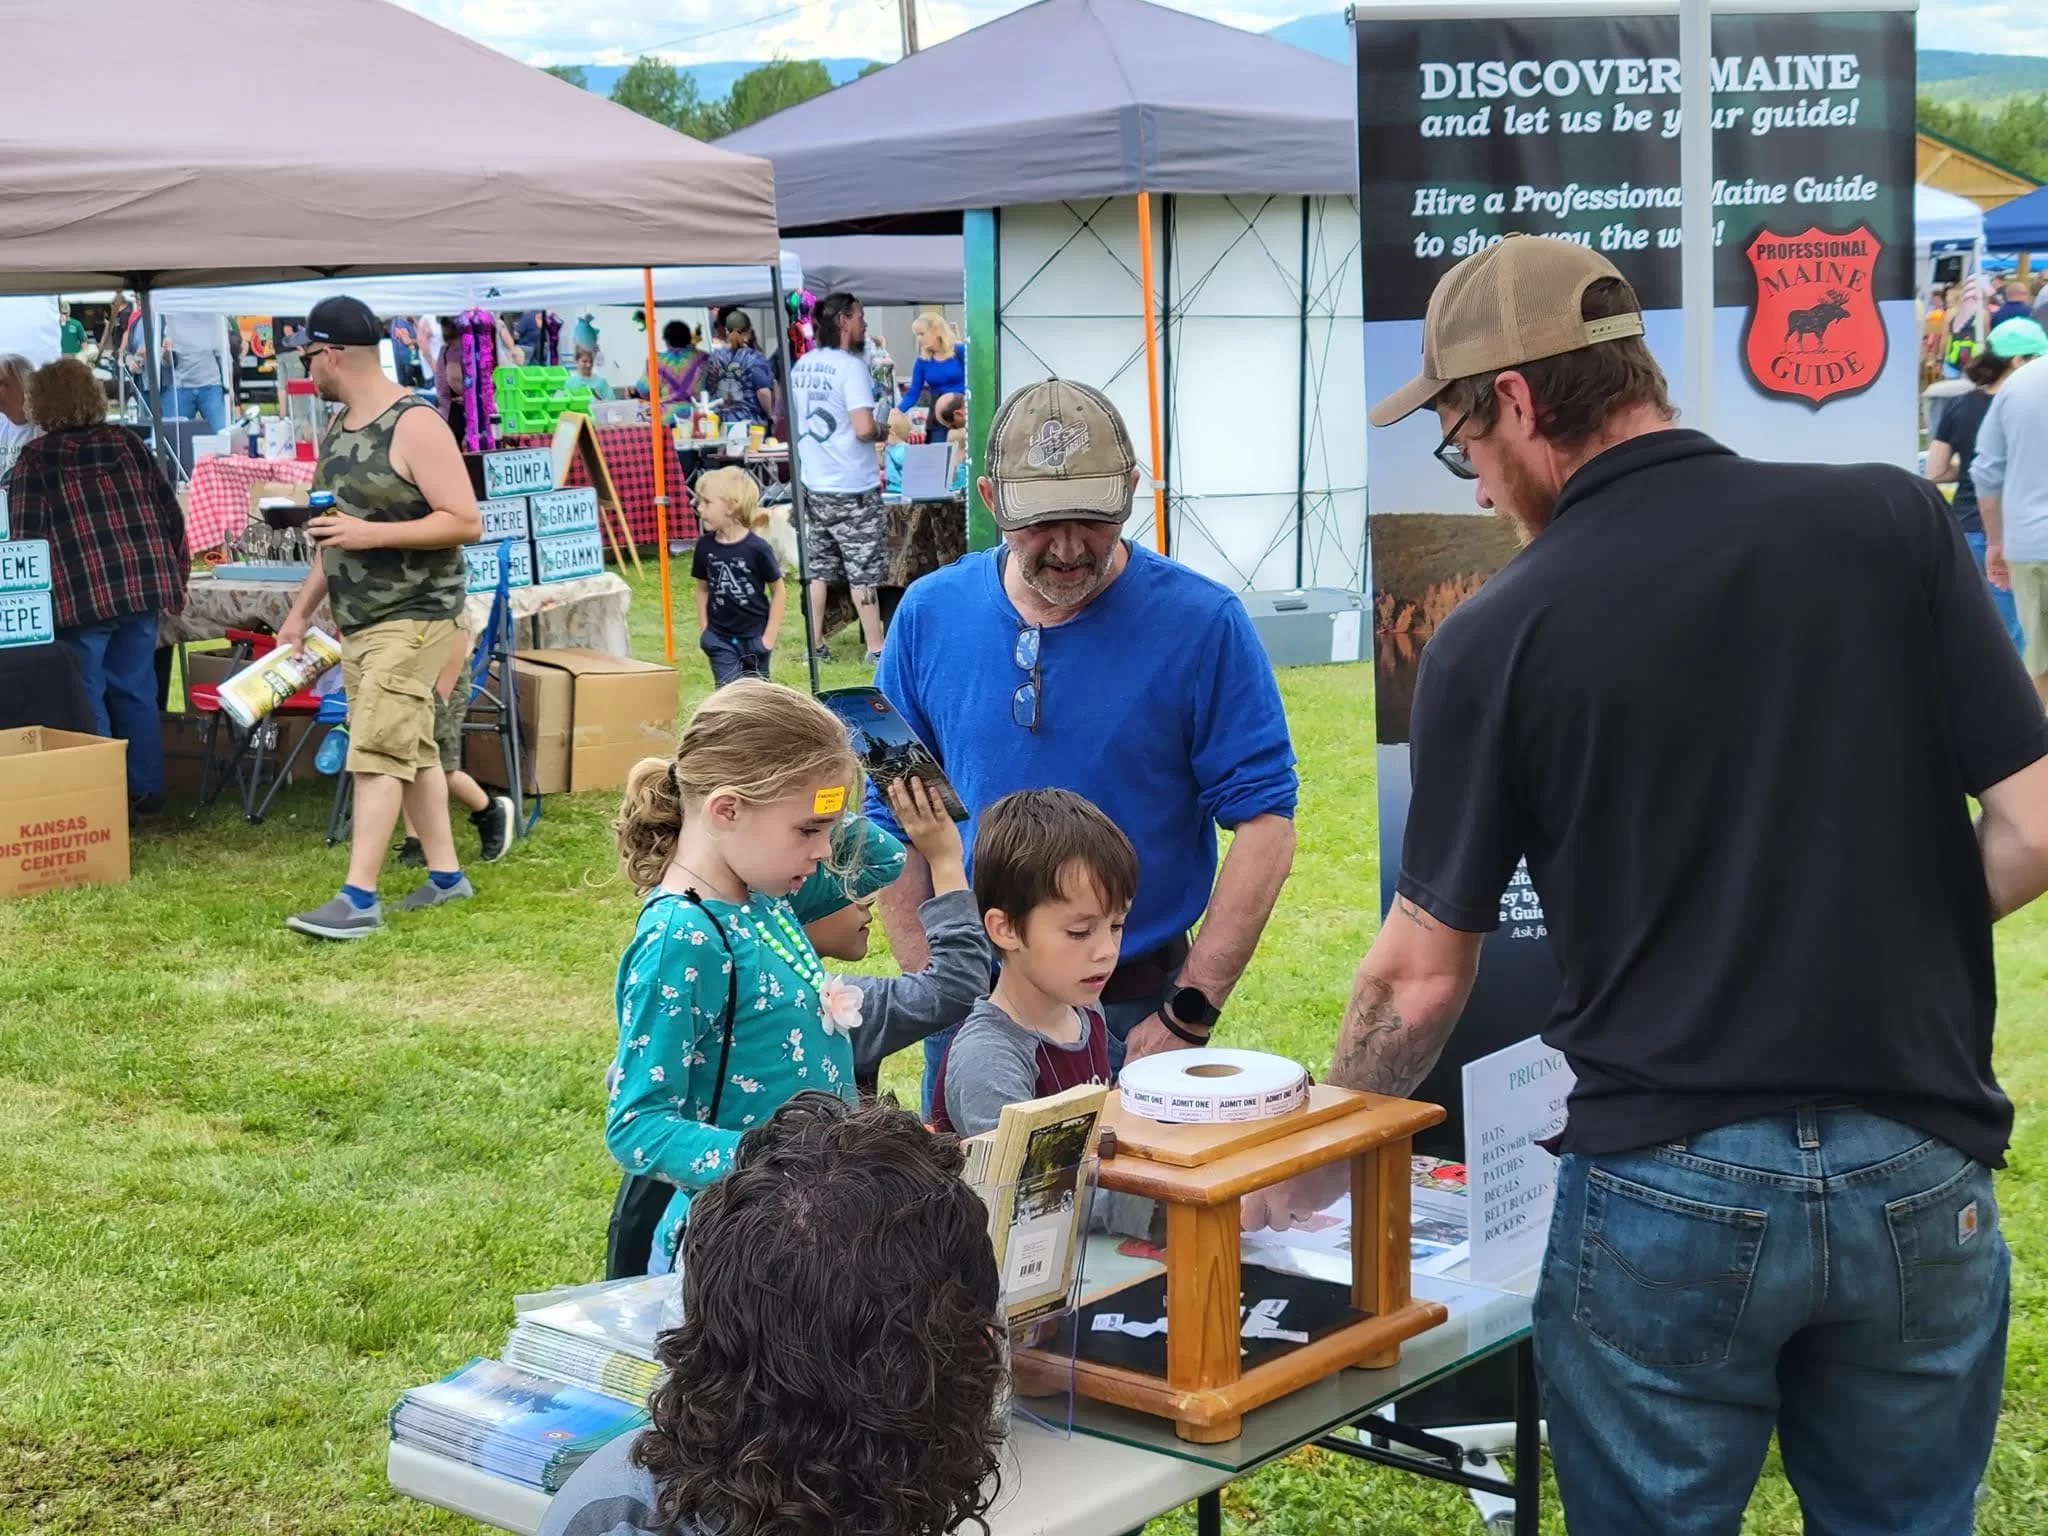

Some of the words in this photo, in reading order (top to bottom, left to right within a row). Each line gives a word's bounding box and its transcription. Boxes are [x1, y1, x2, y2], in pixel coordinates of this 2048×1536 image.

[1420, 58, 1682, 99] DISCOVER
[1710, 54, 1861, 92] MAINE
[1420, 106, 1491, 137] and
[1503, 105, 1550, 135] let
[1560, 110, 1602, 133] us
[1612, 102, 1652, 132] be
[1661, 106, 1744, 138] yur
[1751, 97, 1860, 136] guide!
[1412, 187, 1476, 216] Hire
[1483, 193, 1505, 213] a
[1511, 182, 1683, 219] Professiona
[1793, 174, 1879, 203] Guide
[1413, 231, 1445, 258] to
[1452, 228, 1516, 256] sho
[1600, 222, 1649, 251] the
[1756, 239, 1869, 261] PROFESSIONAL
[1761, 261, 1868, 299] MAINE
[1770, 351, 1865, 386] GUIDE
[504, 461, 551, 485] BUMPA
[482, 510, 524, 533] EMERE
[551, 501, 595, 525] GRAMPY
[2, 555, 40, 580] EME
[555, 545, 600, 570] GRAMMY
[0, 607, 42, 632] EPE
[20, 815, 88, 839] KANSAS
[20, 849, 88, 872] CENTER
[1510, 925, 1534, 938] Ask
[1532, 924, 1548, 940] fo
[1508, 1052, 1562, 1090] PRICING
[1172, 1098, 1194, 1108] ADMIT
[1195, 1100, 1210, 1109] ONE
[1220, 1099, 1242, 1108] ADMIT
[1243, 1098, 1257, 1107] ONE
[1265, 1092, 1283, 1103] ADMIT
[1283, 1089, 1292, 1099] ONE
[1481, 1124, 1505, 1146] HATS
[1482, 1143, 1506, 1165] HATS
[1483, 1154, 1525, 1185] PATCHES
[1484, 1176, 1520, 1204] DECALS
[1484, 1200, 1508, 1224] BELT
[1509, 1182, 1550, 1212] BUCKLES
[1484, 1210, 1528, 1243] ROCKERS
